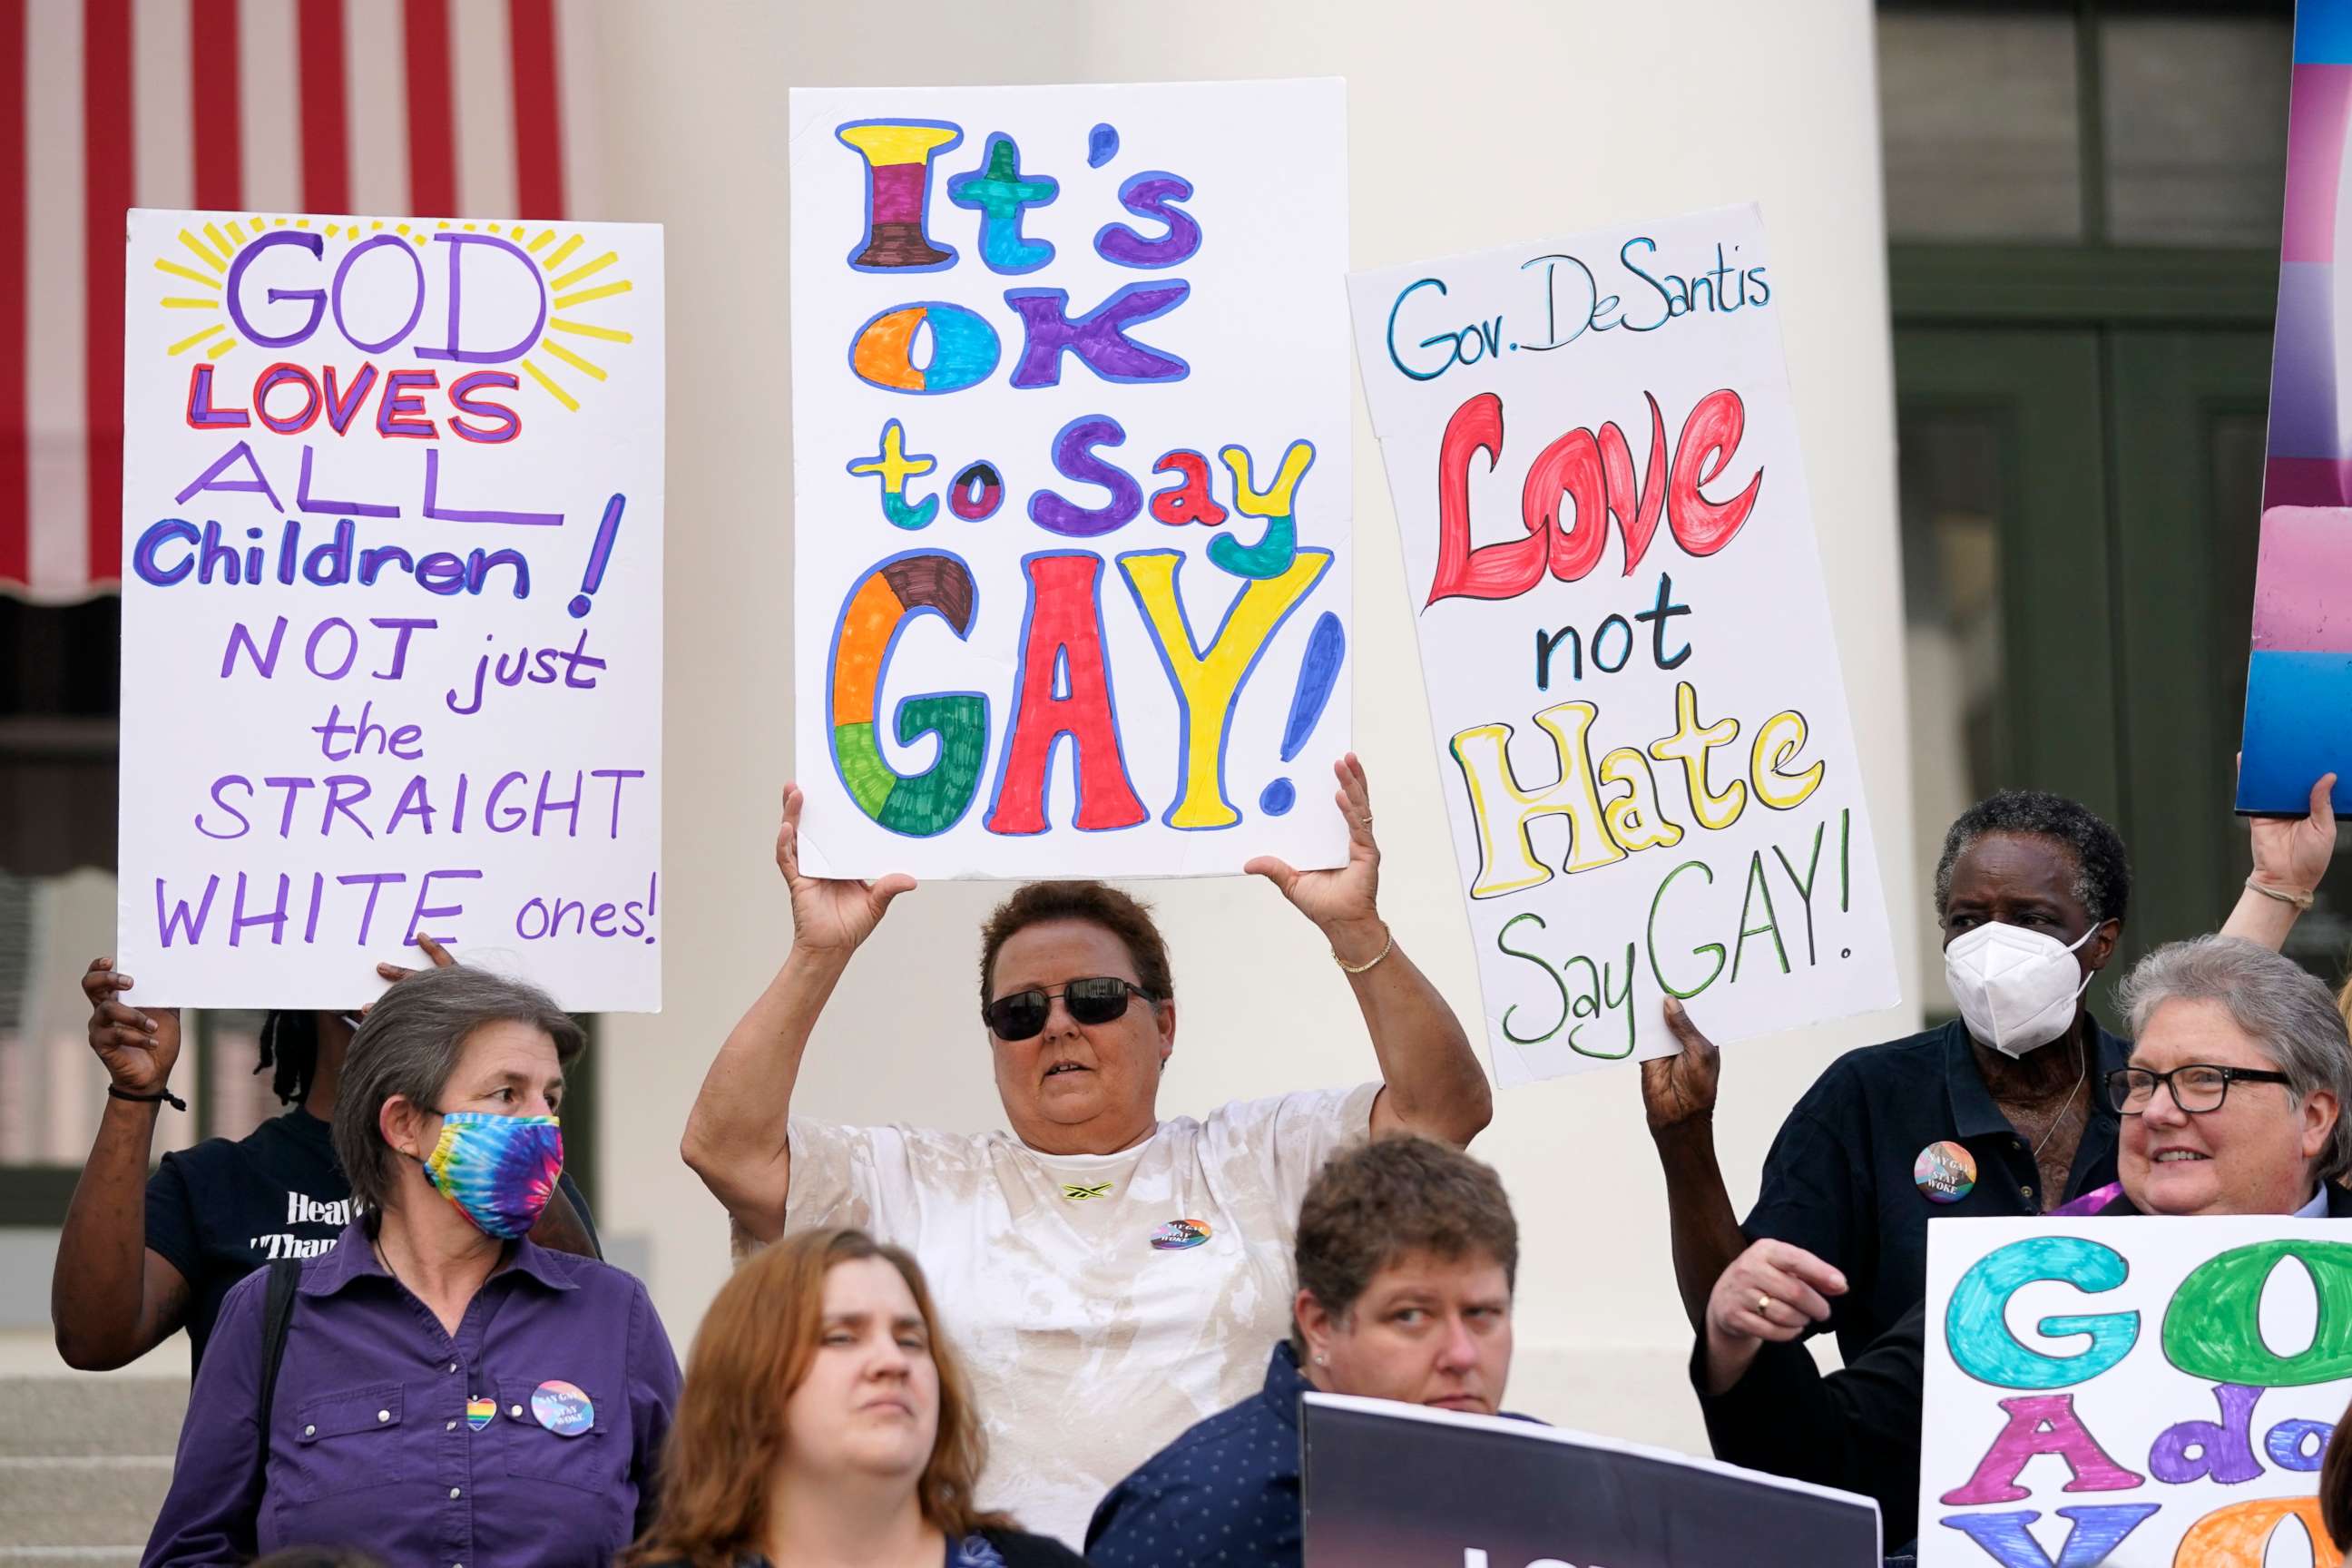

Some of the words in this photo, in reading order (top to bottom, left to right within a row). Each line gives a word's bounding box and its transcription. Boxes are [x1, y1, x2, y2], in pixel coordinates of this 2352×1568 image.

[834, 116, 1203, 276] It's
[226, 230, 547, 365] GOD
[848, 278, 1191, 396] OK
[1386, 277, 1521, 382] Gov.
[185, 361, 523, 445] LOVES
[174, 440, 565, 526] ALL
[845, 416, 1006, 532] to
[1026, 413, 1317, 580] Say
[1420, 388, 1765, 617] Love
[220, 615, 438, 681] NOT
[446, 628, 607, 716] just
[1535, 572, 1692, 692] not
[311, 701, 424, 762] the
[825, 547, 1347, 839] GAY!
[194, 769, 646, 839] STRAIGHT
[1449, 681, 1826, 901] Hate
[155, 869, 484, 948] WHITE
[515, 871, 658, 946] ones!
[1497, 913, 1635, 1060] Say
[1647, 808, 1852, 1000] GAY!
[1927, 1179, 1958, 1195] WOKE
[1932, 1171, 1958, 1184] STAY
